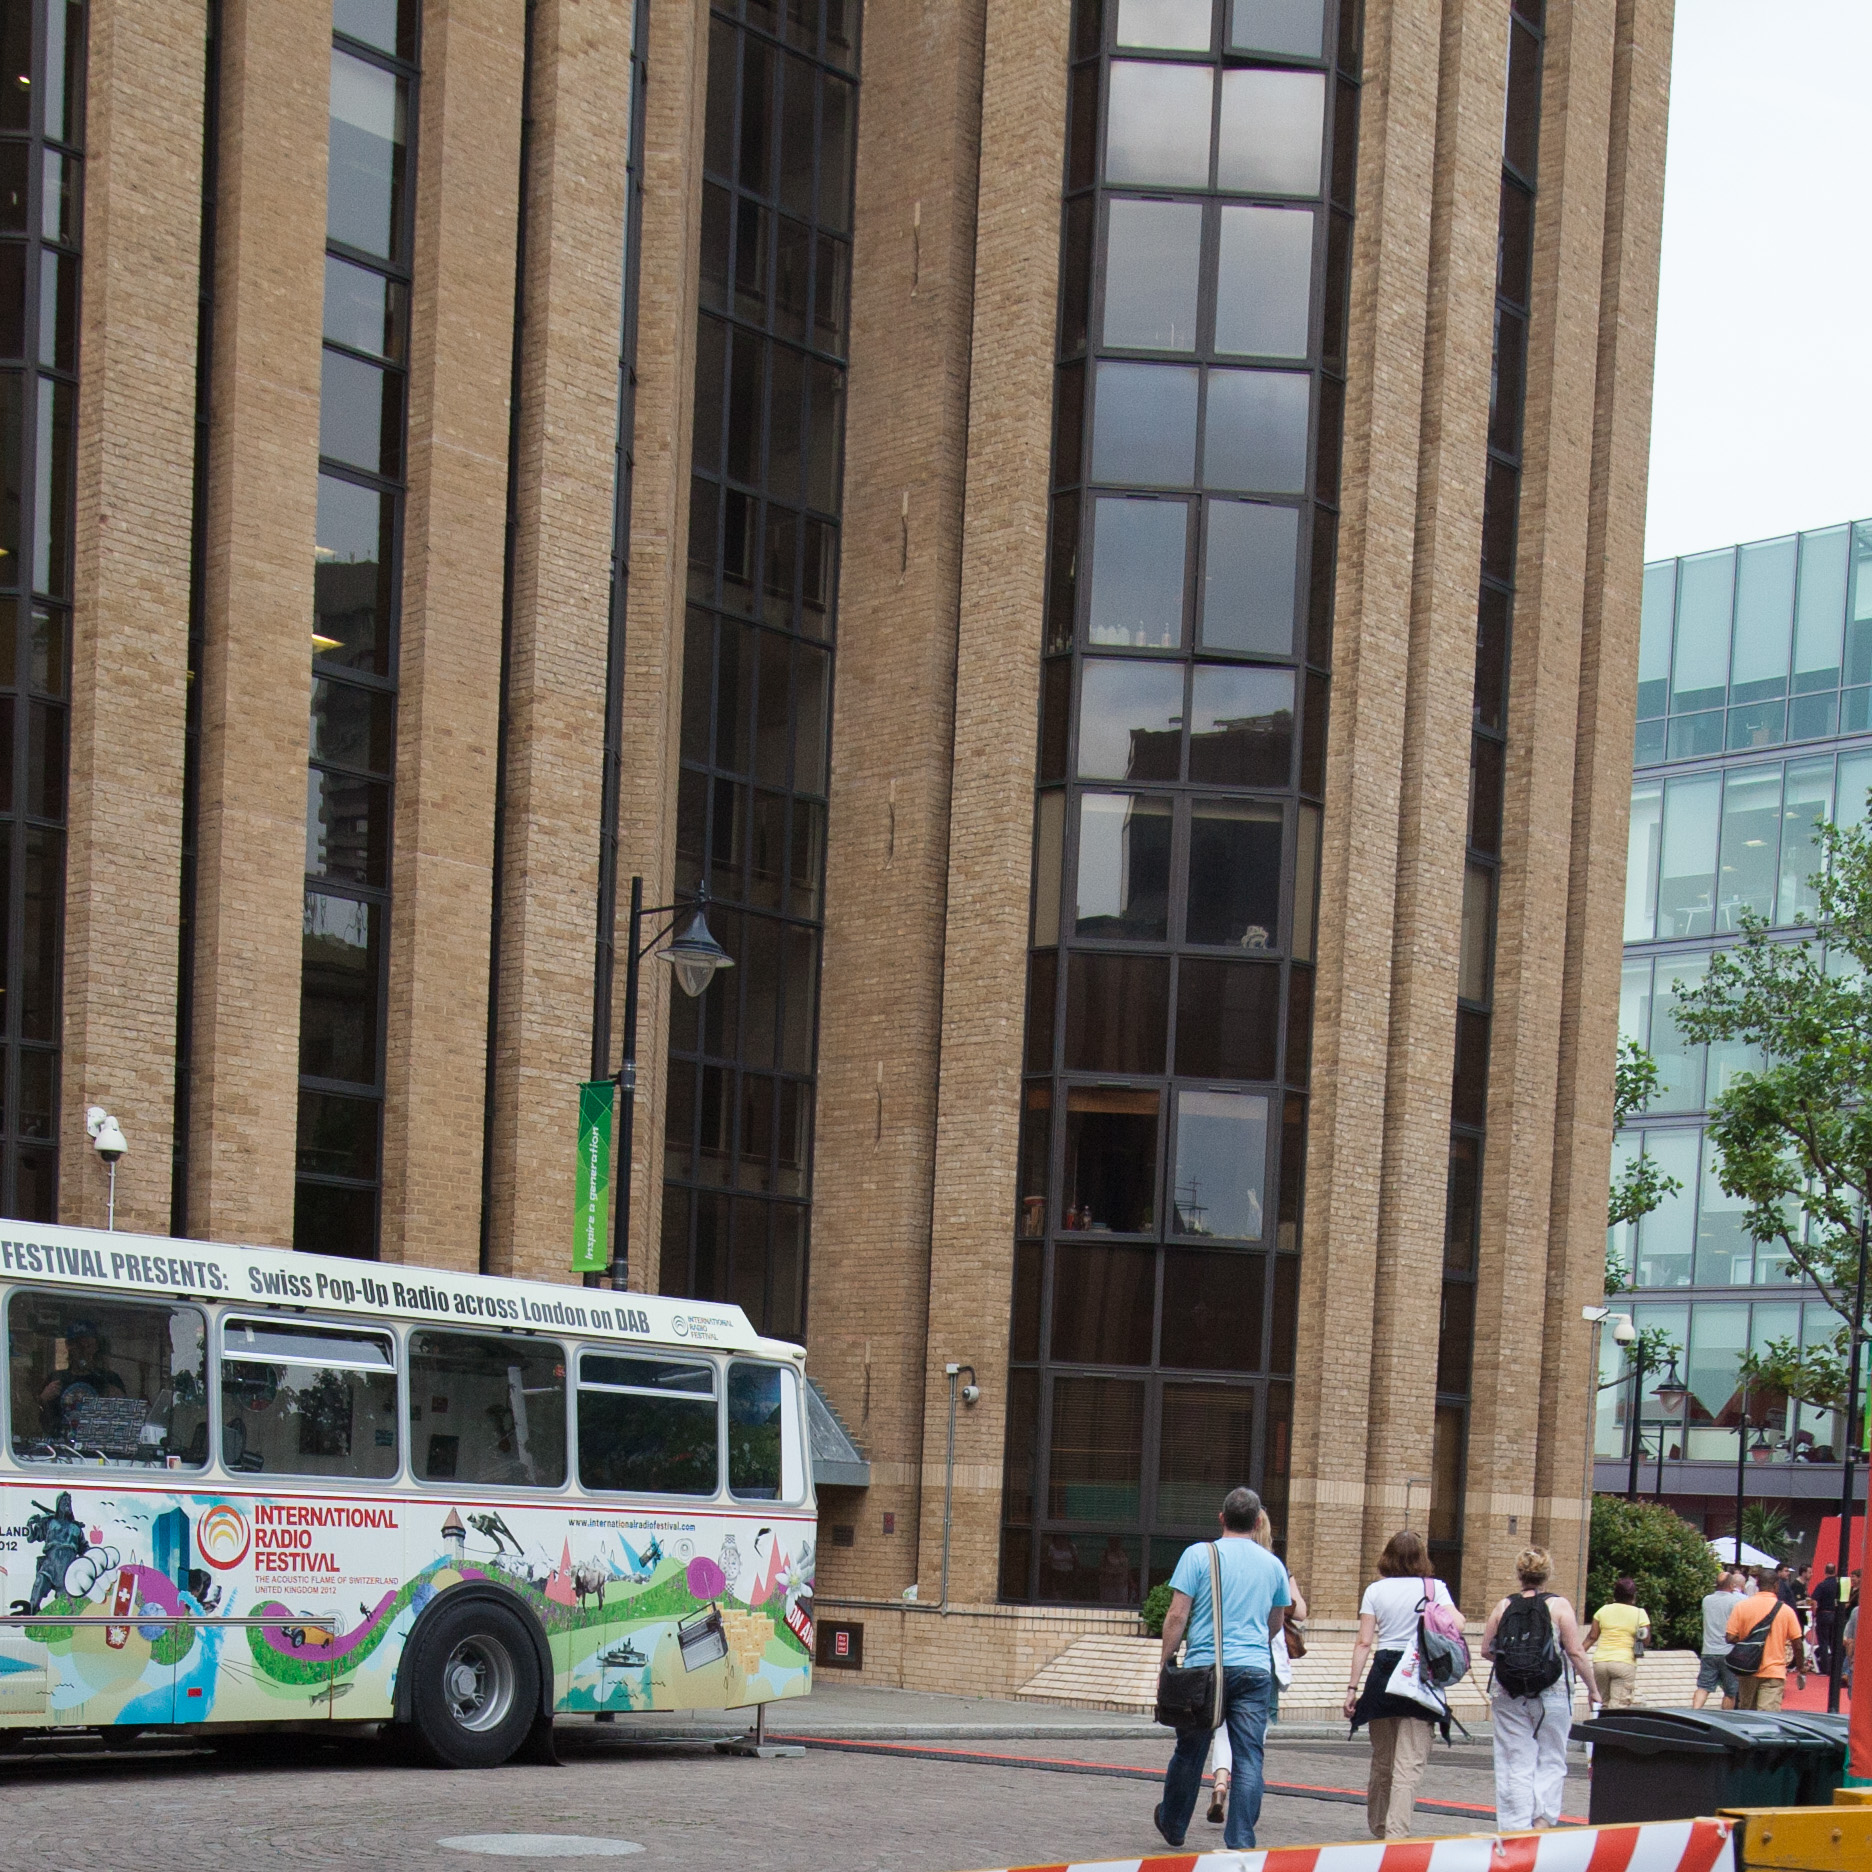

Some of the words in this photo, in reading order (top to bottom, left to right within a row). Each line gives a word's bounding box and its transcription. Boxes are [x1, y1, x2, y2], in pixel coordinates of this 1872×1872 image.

[589, 1125, 599, 1200] generation
[589, 1204, 596, 1212] a
[585, 1215, 595, 1260] Inspire
[1, 1240, 108, 1279] FESTIVAL
[110, 1252, 229, 1291] PRESENTS:
[248, 1266, 313, 1298] Swiss
[316, 1272, 389, 1307] Pop-Up
[392, 1281, 450, 1312] Radio
[454, 1293, 519, 1320] across
[520, 1297, 588, 1328] London
[591, 1309, 614, 1330] on
[614, 1308, 650, 1334] DAB
[687, 1315, 733, 1328] INTERNATIONAL
[689, 1323, 708, 1333] RADIO
[691, 1331, 719, 1341] FESTIVAL
[255, 1505, 398, 1528] INTERNATIONAL
[568, 1517, 696, 1532] www.internationalradiofestival.com
[255, 1529, 312, 1549] RADIO
[255, 1552, 340, 1572] FESTIVAL
[255, 1575, 270, 1584] THE
[272, 1575, 309, 1585] ACOUSTIC
[311, 1576, 336, 1585] FLAME
[337, 1576, 347, 1585] OF
[349, 1576, 399, 1585] SWITZERLAND
[255, 1585, 282, 1594] UNITED
[284, 1585, 319, 1594] KINGDOM
[320, 1586, 336, 1594] 2012
